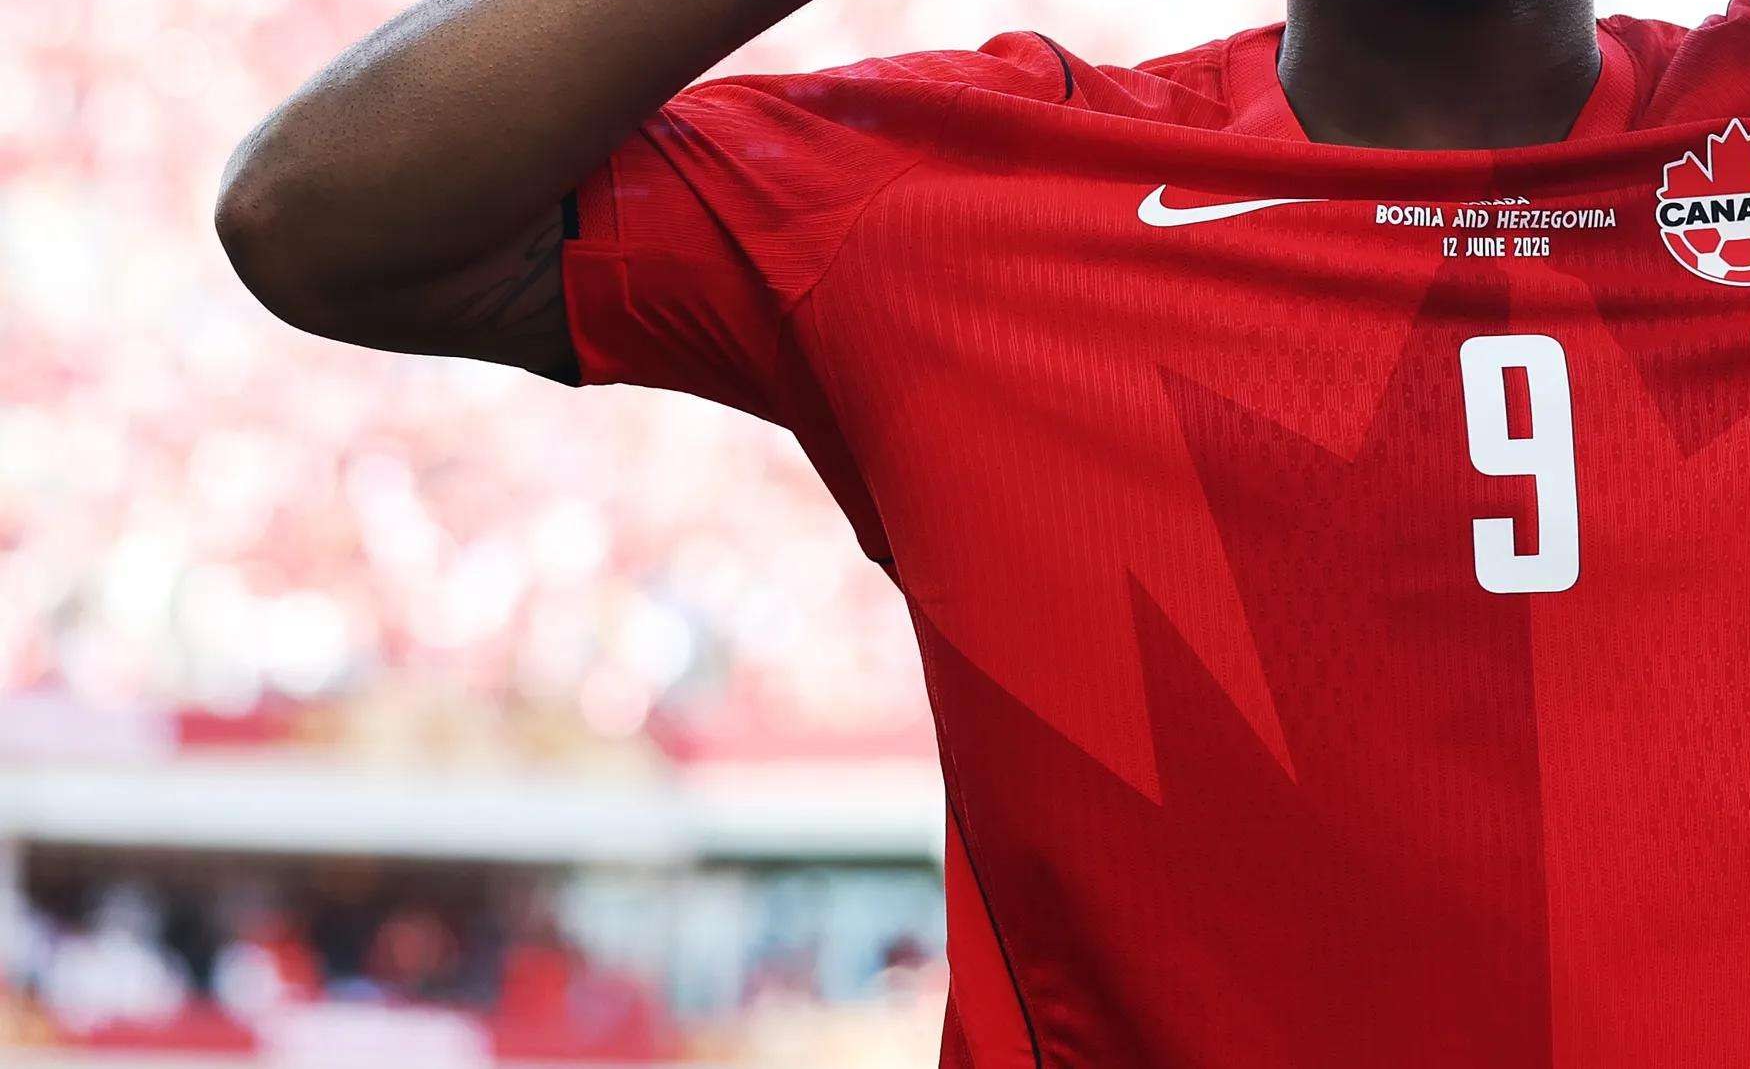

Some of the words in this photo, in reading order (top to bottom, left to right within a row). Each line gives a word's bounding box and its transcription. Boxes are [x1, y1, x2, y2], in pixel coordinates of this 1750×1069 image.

[1375, 205, 1444, 227] BOSNIA
[1452, 209, 1489, 228] AND
[1496, 209, 1616, 229] HERZEGOVINA
[1442, 237, 1457, 257] 12
[1465, 237, 1506, 257] JUNE
[1513, 237, 1550, 257] 2026
[1459, 334, 1580, 594] 9
